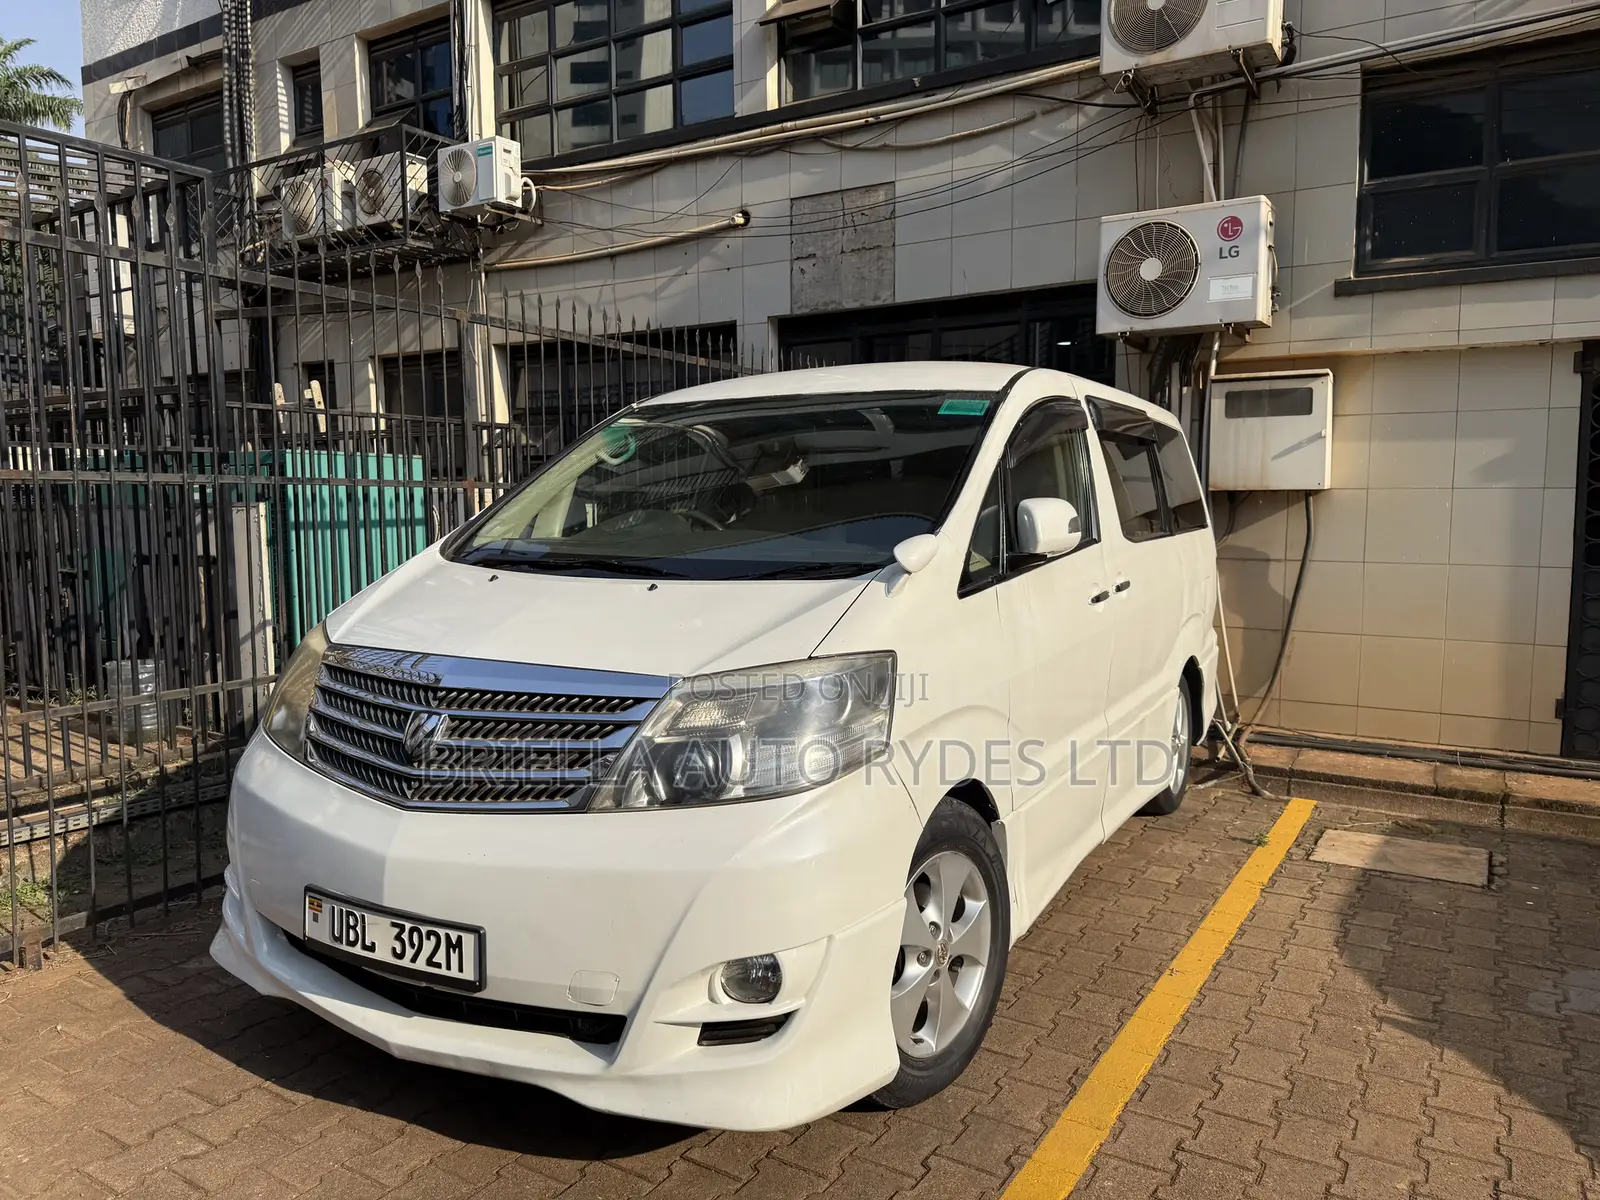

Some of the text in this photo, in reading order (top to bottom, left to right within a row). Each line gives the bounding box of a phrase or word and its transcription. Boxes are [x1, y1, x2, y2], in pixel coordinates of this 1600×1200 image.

[1219, 245, 1240, 260] LG
[331, 904, 464, 973] UBL 392M
